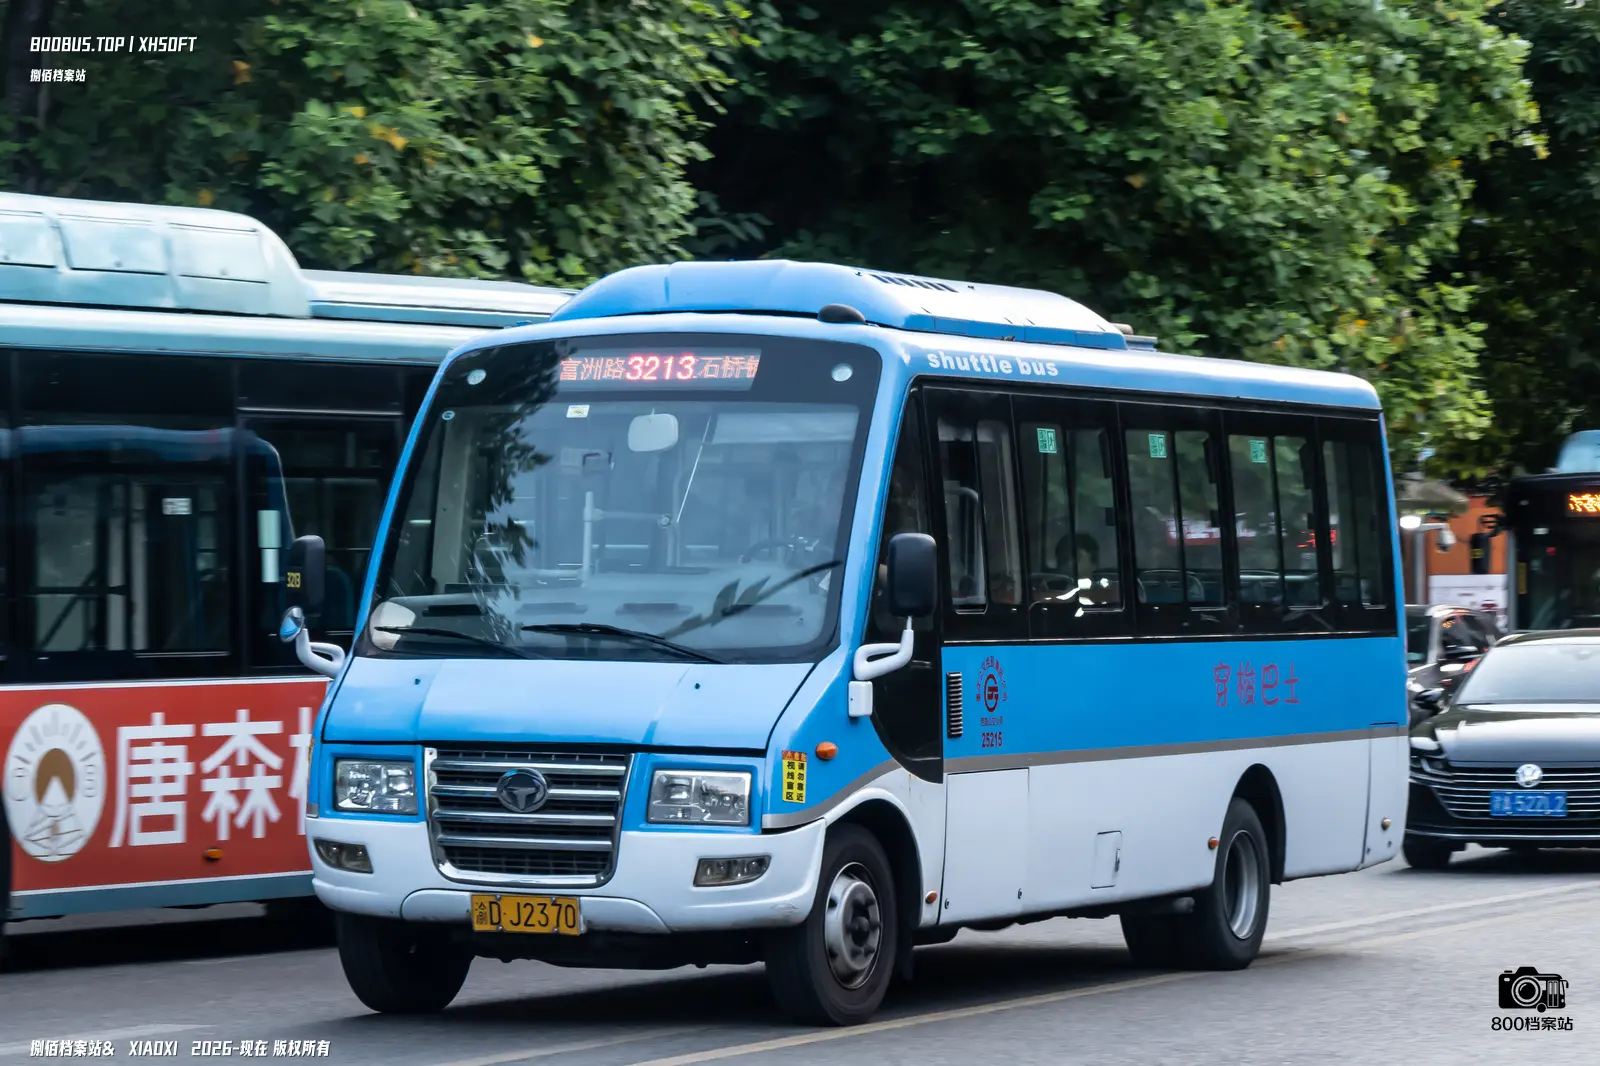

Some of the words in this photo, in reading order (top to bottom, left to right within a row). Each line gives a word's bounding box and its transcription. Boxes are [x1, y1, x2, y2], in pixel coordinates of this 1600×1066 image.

[625, 354, 698, 381] 3213
[926, 350, 1014, 375] shuttle
[1015, 355, 1059, 377] bus
[1213, 660, 1301, 707] 穿梭巴士
[981, 731, 1003, 748] 25215
